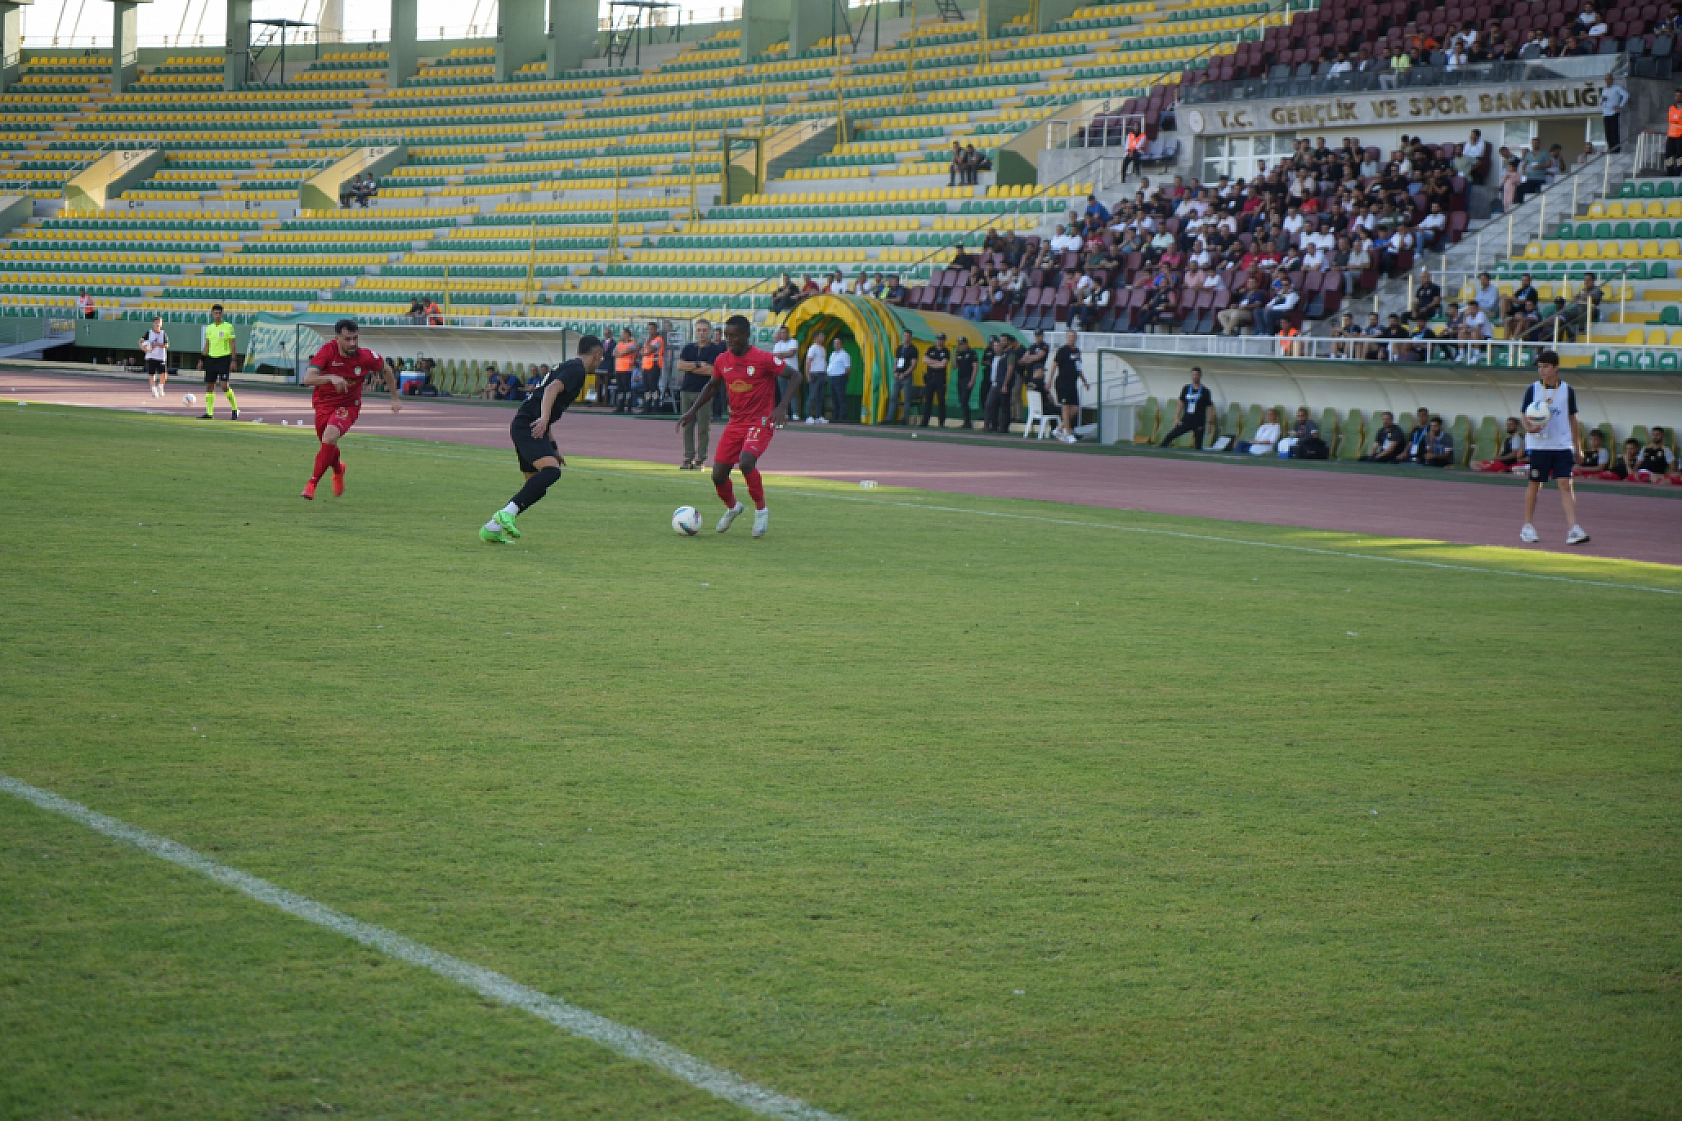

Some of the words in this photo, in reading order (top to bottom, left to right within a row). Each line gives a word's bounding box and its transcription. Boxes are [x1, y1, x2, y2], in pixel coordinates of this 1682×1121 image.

[1217, 110, 1254, 128] T.C.
[1270, 99, 1358, 127] GENÇLİK
[1370, 98, 1399, 119] VE
[1408, 95, 1468, 116] SPOR
